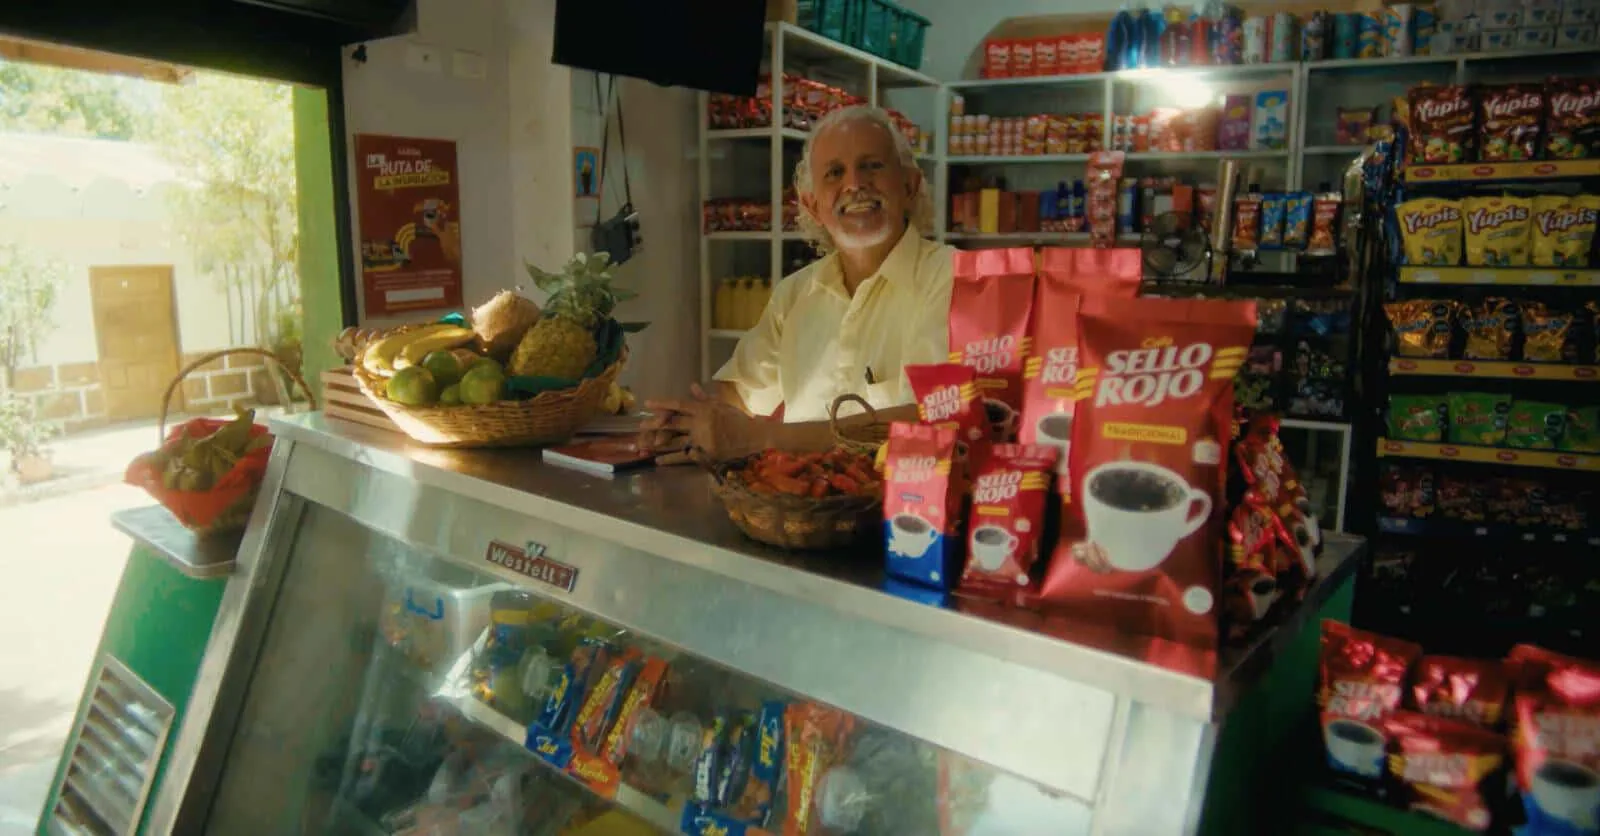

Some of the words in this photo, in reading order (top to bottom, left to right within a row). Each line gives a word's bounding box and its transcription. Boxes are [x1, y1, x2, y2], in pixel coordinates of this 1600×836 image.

[1416, 96, 1469, 123] Yupis
[1483, 94, 1542, 121] Yupis
[1551, 94, 1600, 118] Yupi
[380, 160, 412, 175] RUTA
[415, 159, 432, 173] DE
[1403, 206, 1460, 233] Yupis
[1467, 204, 1529, 234] Yupis
[1537, 206, 1598, 236] Yupis
[965, 335, 1014, 357] SELLO
[1047, 347, 1078, 366] SEL
[963, 350, 1011, 373] ROJO
[1104, 343, 1212, 375] SELLO
[1041, 361, 1077, 385] RO
[923, 385, 960, 406] SELLO
[1096, 369, 1204, 407] ROJO
[926, 399, 961, 422] ROJO
[893, 467, 934, 483] ROJO
[896, 456, 937, 472] SELLO
[976, 470, 1022, 489] SELLO
[972, 483, 1018, 504] ROJO
